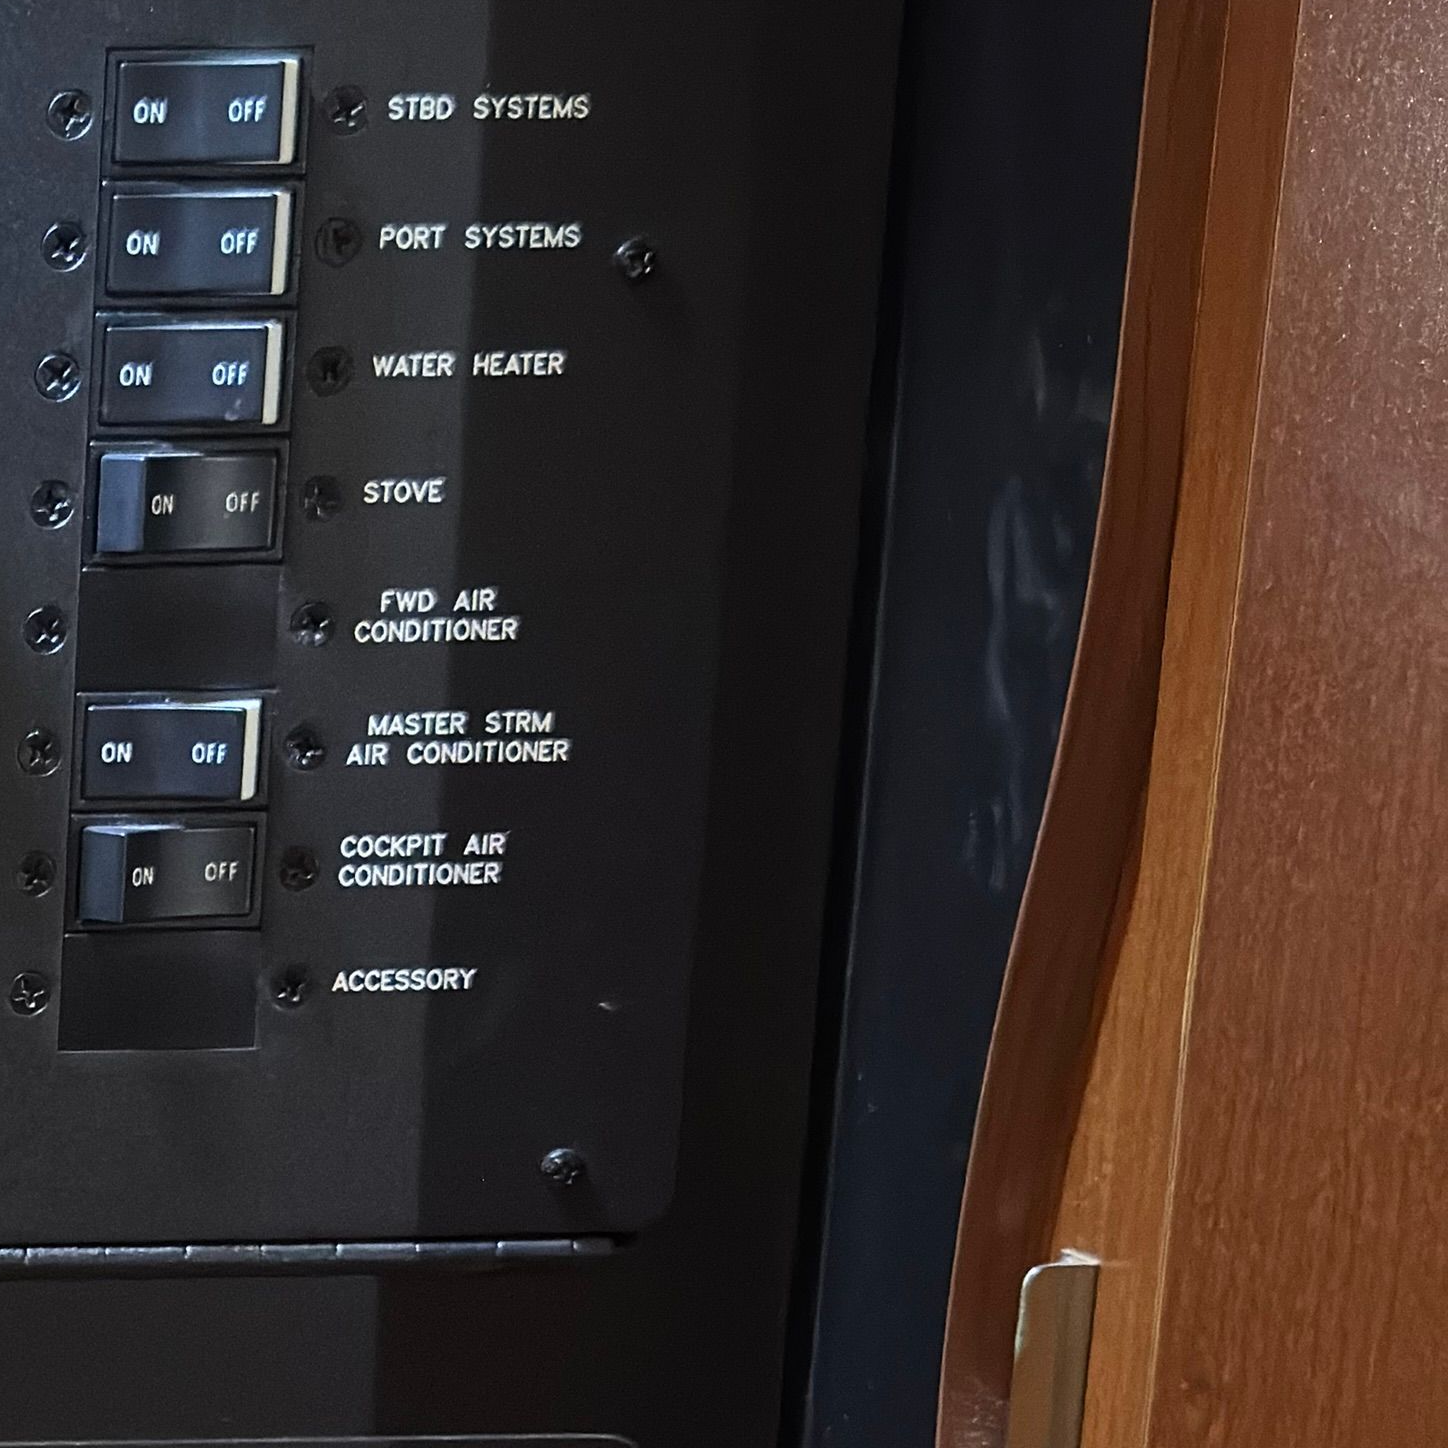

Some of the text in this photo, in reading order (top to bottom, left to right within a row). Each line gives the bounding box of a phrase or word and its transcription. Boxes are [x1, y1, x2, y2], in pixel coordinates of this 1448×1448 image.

[132, 99, 265, 124] ON OFF
[389, 94, 588, 120] STBD SYSTEMS
[380, 224, 580, 249] PORT SYSTEMS
[373, 352, 564, 376] WATER HEATER
[364, 479, 443, 503] STOVE
[381, 588, 495, 612] FWD AIR
[355, 618, 517, 642] CONDITIONER
[368, 710, 552, 735] MASTER STRM
[347, 740, 569, 765] AIR CONDITIONER
[341, 833, 505, 858] COCKPIT AIR
[339, 862, 499, 886] CONDITIONER
[332, 968, 476, 991] ACCESSORY
